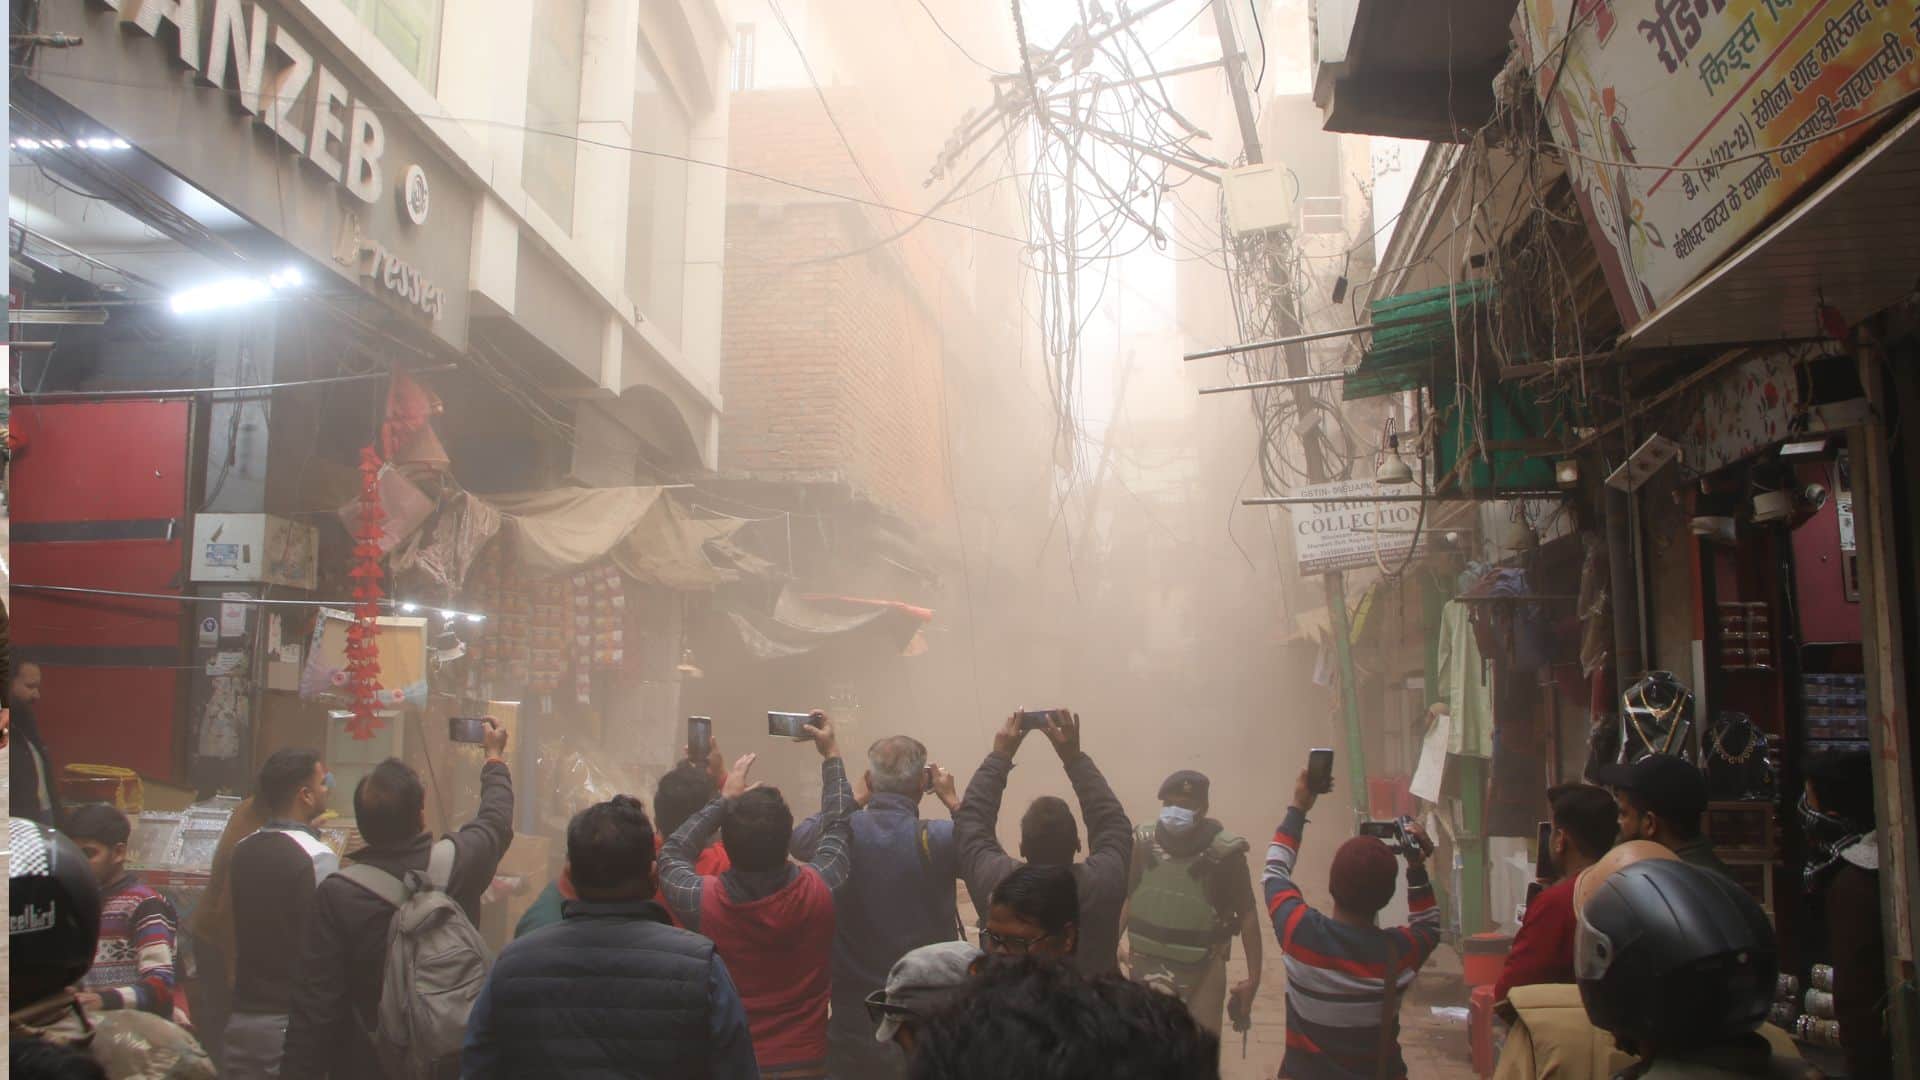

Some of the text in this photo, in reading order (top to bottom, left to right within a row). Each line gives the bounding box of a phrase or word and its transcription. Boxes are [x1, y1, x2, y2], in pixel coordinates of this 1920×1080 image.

[98, 0, 385, 203] ANZEB
[1751, 77, 1793, 130] रंगीला
[1789, 48, 1821, 92] शाह
[1726, 184, 1742, 211] के
[1298, 506, 1421, 536] COLLECTION
